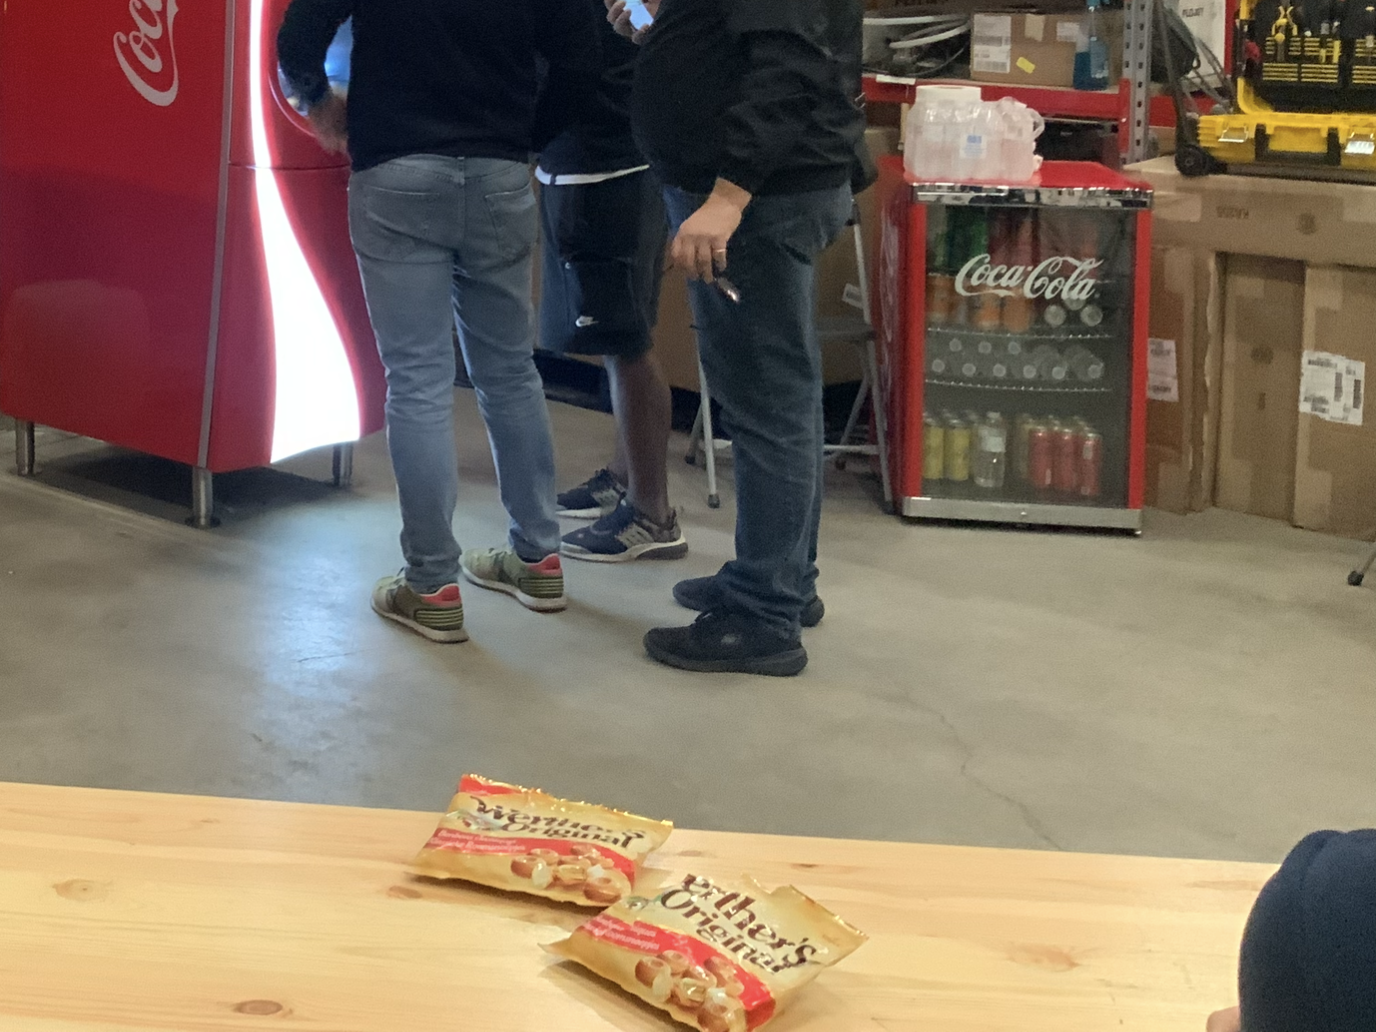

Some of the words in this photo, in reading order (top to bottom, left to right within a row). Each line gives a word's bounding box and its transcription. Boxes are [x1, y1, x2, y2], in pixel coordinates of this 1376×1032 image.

[954, 253, 1104, 300] Coca-Cola
[469, 795, 646, 839] Werthes
[681, 873, 817, 966] erther's
